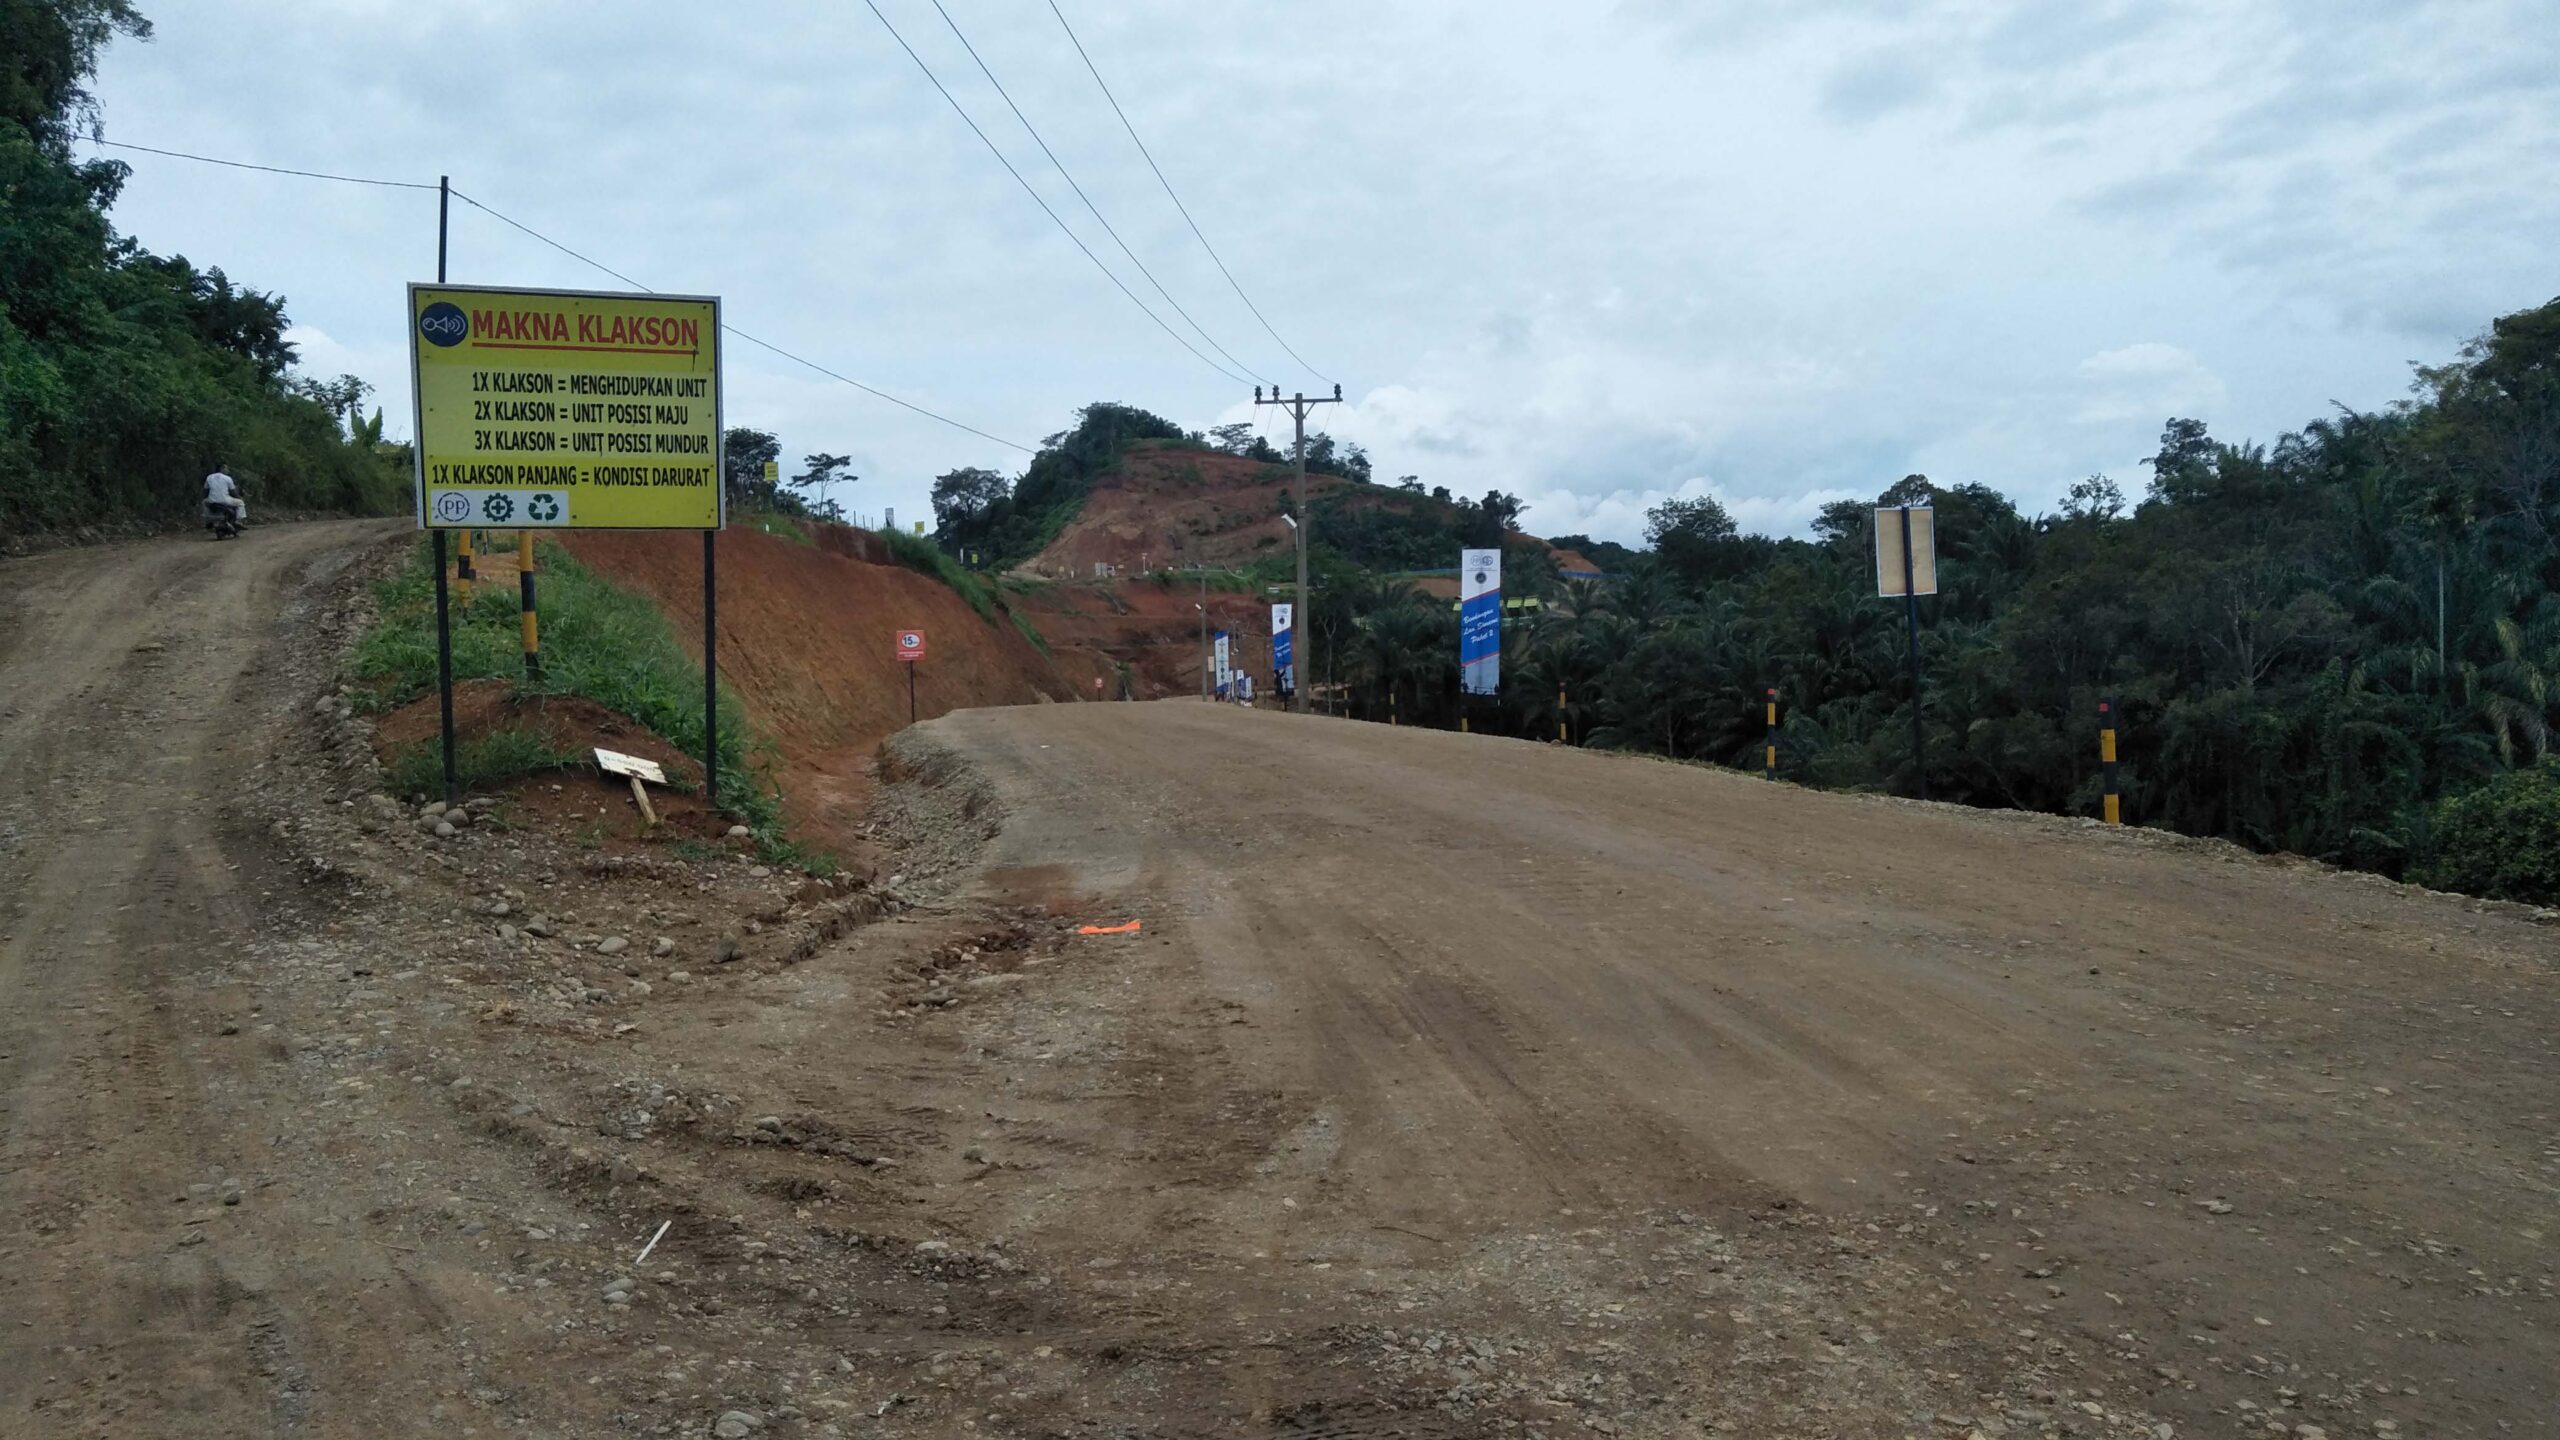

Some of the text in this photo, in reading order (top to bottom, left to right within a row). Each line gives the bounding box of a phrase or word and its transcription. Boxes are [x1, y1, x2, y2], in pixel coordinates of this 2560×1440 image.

[472, 310, 698, 346] MAKNA KLAKSON
[472, 372, 707, 398] 1X KLAKSON = MENGHIDUPKAN UNIT
[475, 400, 688, 425] 2X KLAKSON = UNIT POSISI MAJU
[475, 430, 709, 454] 3X KLAKSON = UNIT POSISI MUNDUR
[432, 465, 710, 487] 1X KLAKSON PANJANG = KONDISI DARURAT
[444, 499, 465, 516] PP
[903, 636, 913, 645] 15
